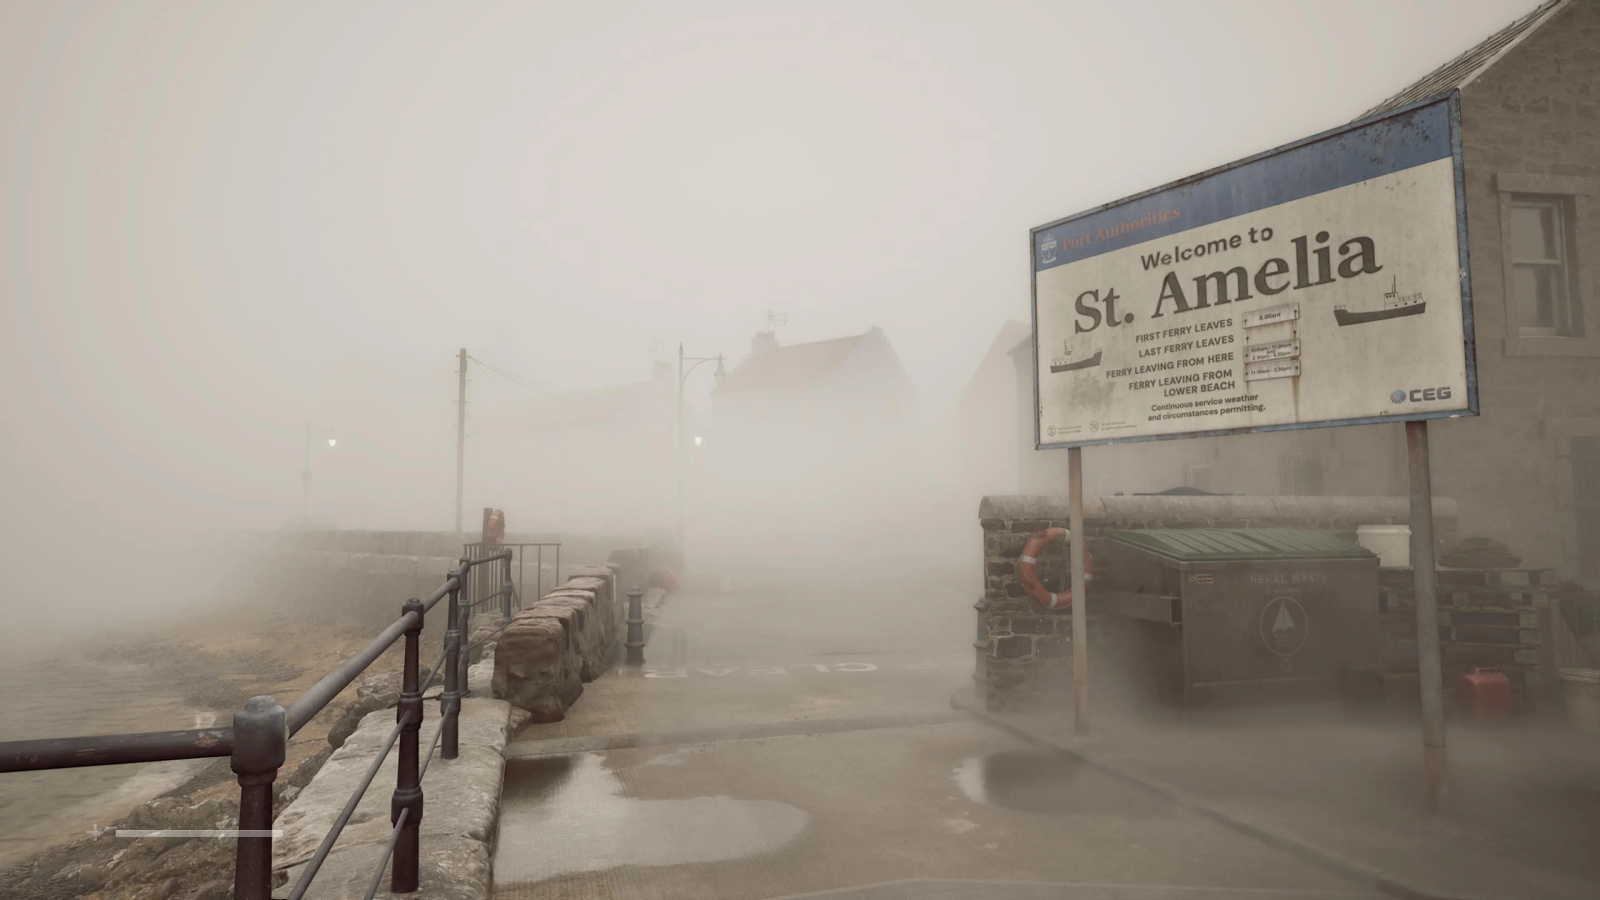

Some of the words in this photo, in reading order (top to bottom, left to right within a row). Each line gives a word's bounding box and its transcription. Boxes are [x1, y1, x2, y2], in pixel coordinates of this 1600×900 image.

[1062, 233, 1091, 251] Port
[1095, 207, 1181, 240] Authorities
[1141, 234, 1242, 271] Welcome
[1248, 227, 1273, 243] to
[1074, 287, 1134, 334] St.
[1151, 231, 1383, 318] Amelia
[1135, 331, 1160, 343] FIRST
[1162, 326, 1192, 338] FERRY
[1194, 318, 1233, 333] LEAVES
[1138, 346, 1162, 358] LAST
[1164, 341, 1193, 353] FERRY
[1196, 334, 1234, 348] LEAVES
[1106, 367, 1132, 379] FERRY
[1134, 361, 1174, 374] LEAVING
[1176, 356, 1204, 368] FROM
[1207, 352, 1234, 364] HERE
[1128, 380, 1156, 391] FERRY
[1158, 373, 1200, 387] LEAVING
[1202, 369, 1232, 381] FROM
[1164, 385, 1198, 397] LOWER
[1200, 381, 1235, 393] BEACH
[1151, 401, 1193, 412] Continuous
[1194, 397, 1223, 407] service
[1224, 394, 1258, 404] weather
[1409, 386, 1451, 402] CEG
[1147, 413, 1162, 421] and
[1162, 407, 1218, 419] circumstances
[1220, 404, 1266, 415] permitting.
[1291, 572, 1328, 583] WASTE
